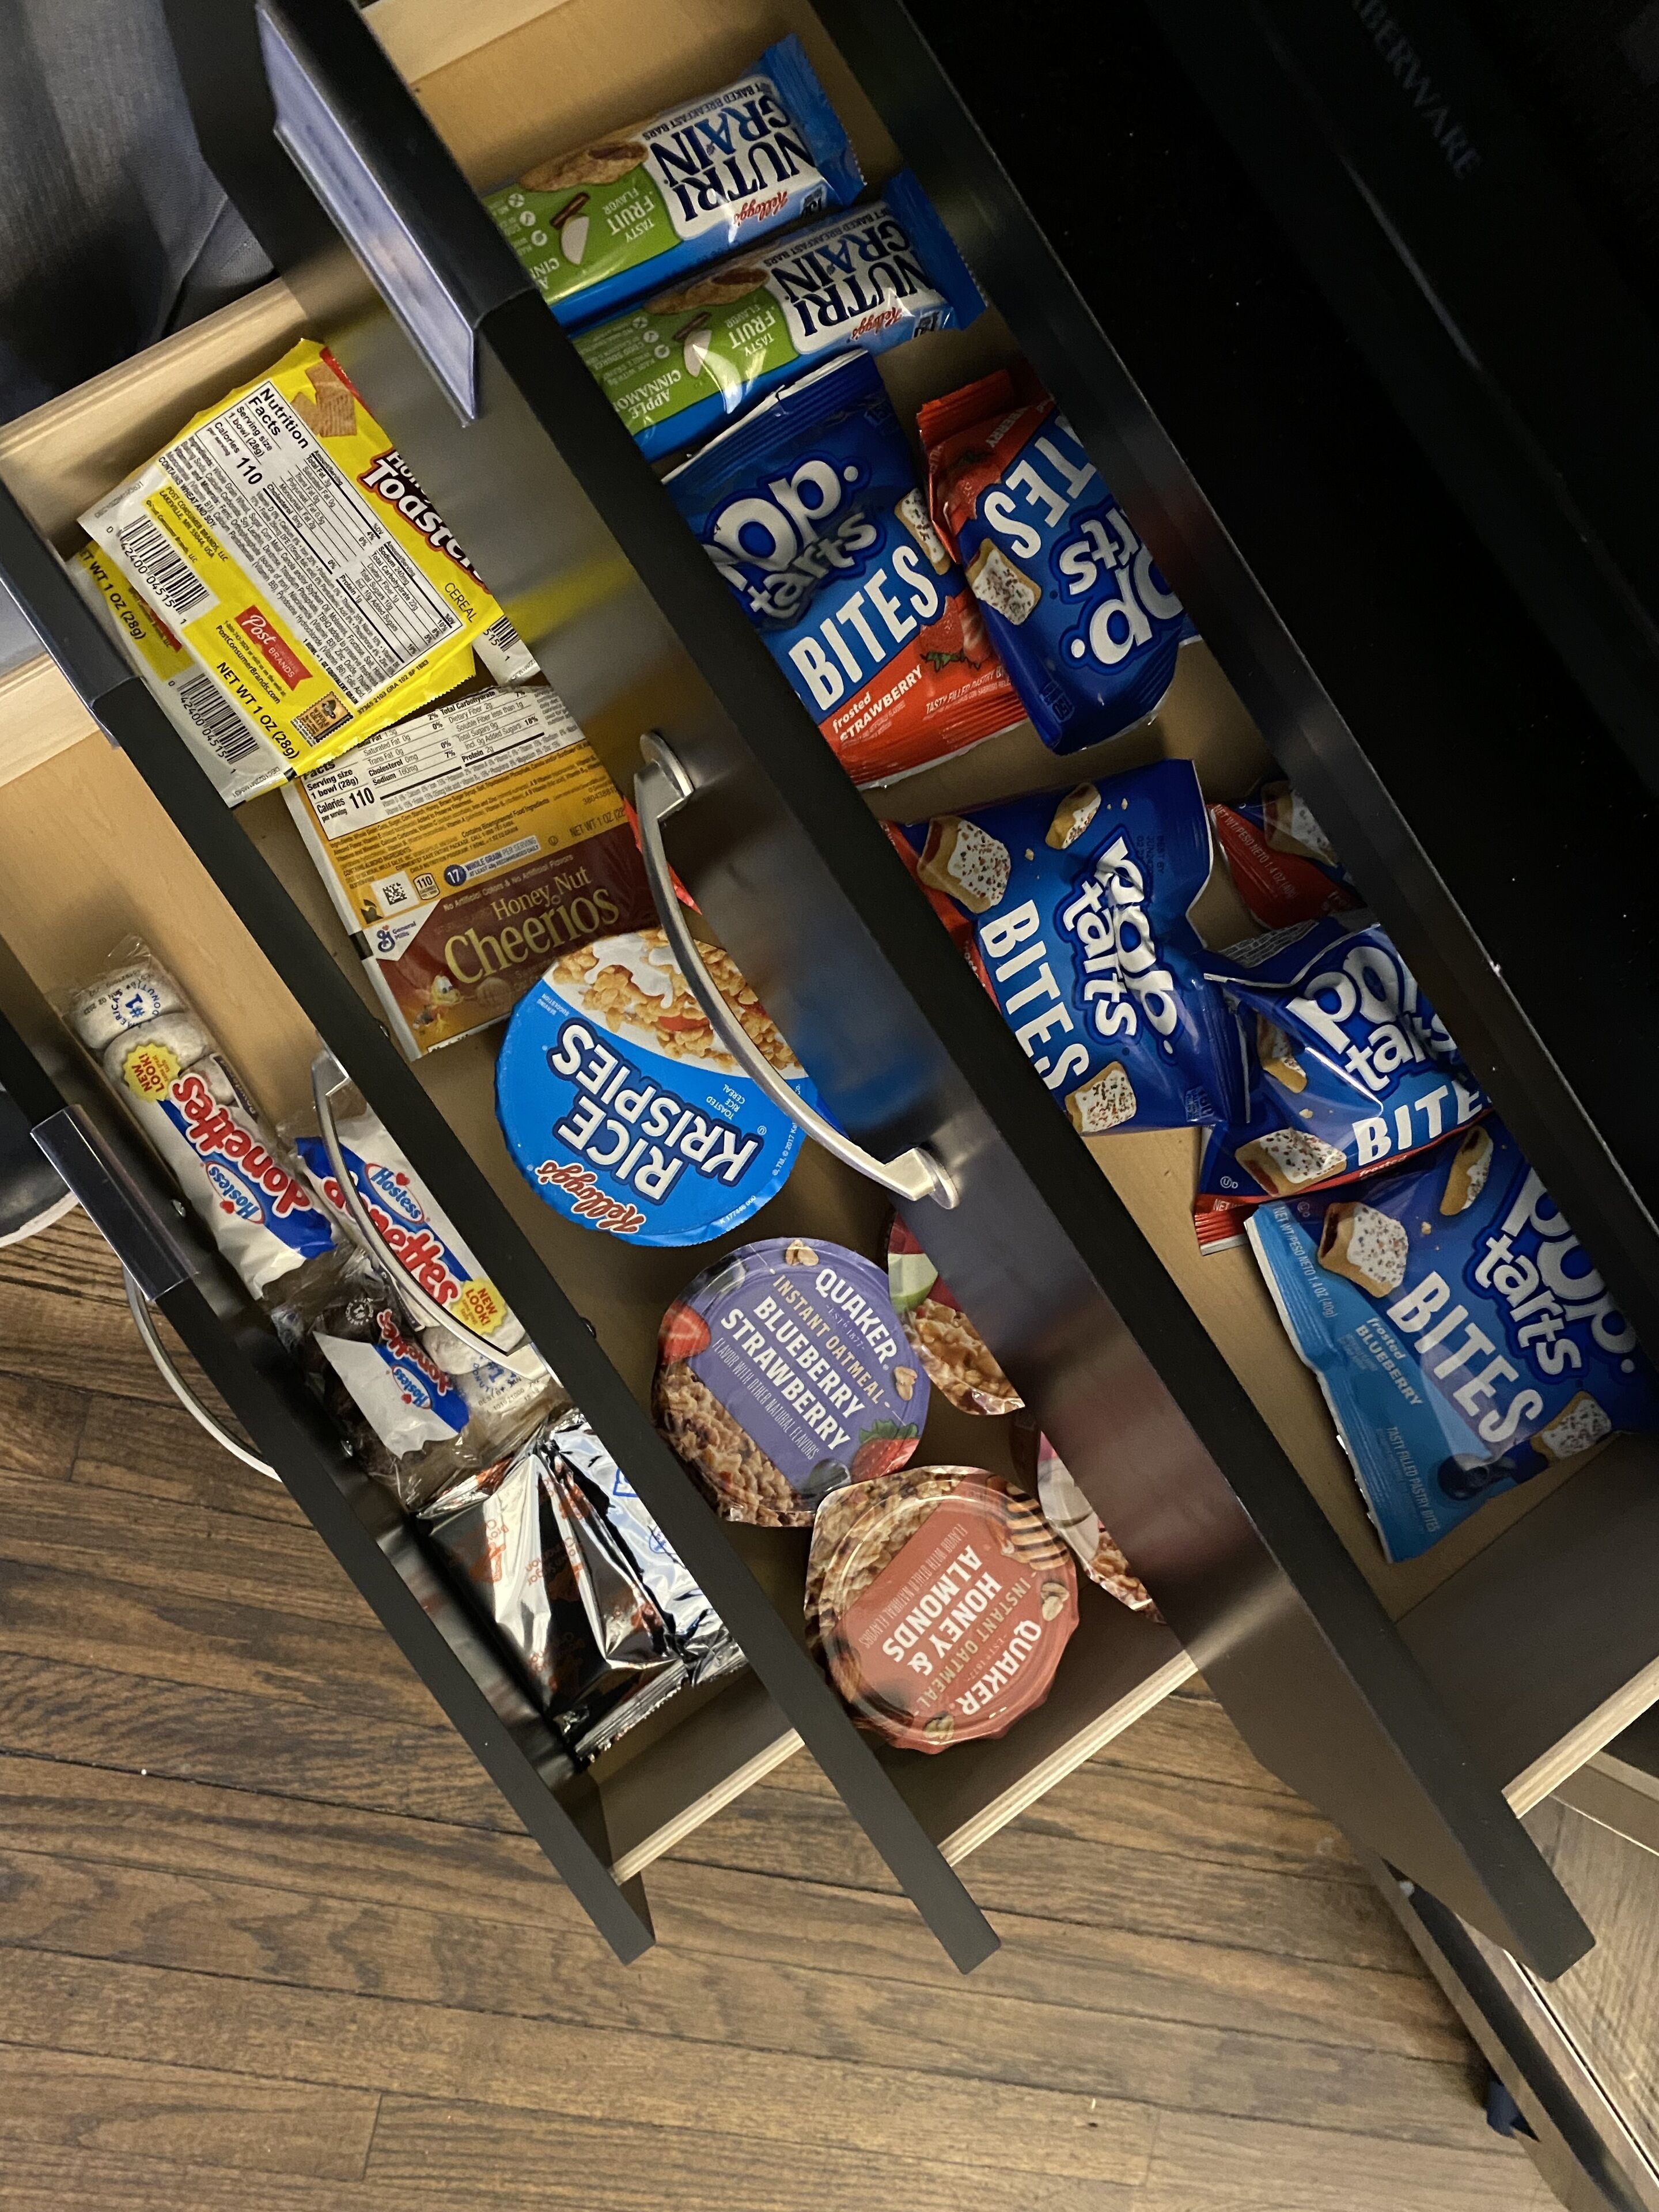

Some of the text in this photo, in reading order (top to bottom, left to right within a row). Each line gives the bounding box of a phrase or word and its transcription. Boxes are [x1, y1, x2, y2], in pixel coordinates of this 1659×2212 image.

[642, 84, 755, 141] BAKED BREAKFAST BARS
[652, 91, 791, 188] GRAIN
[600, 187, 641, 214] FLAVOR
[672, 130, 815, 223] NUTRI
[604, 196, 657, 235] FRUIT
[622, 218, 656, 243] TASTY
[733, 191, 789, 228] Kellogg's
[763, 215, 873, 267] BAKED BREAKFAST BARS
[772, 219, 910, 304] GRAIN
[722, 302, 762, 328] FLAVOR
[792, 257, 927, 338] NUTRI
[850, 305, 903, 339] Kellogg's
[723, 310, 778, 349] FRUIT
[741, 332, 775, 355] TASTY
[234, 405, 274, 452] Serving size
[247, 395, 283, 437] Facts
[259, 387, 312, 449] Nutrition
[627, 388, 674, 419] APPLE
[214, 421, 241, 453] Calories
[232, 418, 266, 459] bowl (28g)
[158, 455, 217, 529] CONTAINS WHEAT AND SOY.
[234, 454, 264, 487] 110
[984, 426, 1097, 559] TES
[165, 485, 228, 562] POST CONSUMER LLC
[181, 517, 193, 530] MN
[203, 546, 215, 559] USA
[1059, 507, 1141, 595] rts
[120, 541, 148, 575] 42400
[146, 574, 175, 609] 04515
[751, 510, 877, 619] tarts
[88, 560, 147, 642] WT 1 OZ (28g)
[443, 581, 479, 623] CEREAL
[789, 544, 939, 711] BITES
[240, 611, 278, 652] Post
[215, 623, 281, 706] PostConsumerBrands.com
[267, 646, 294, 679] BRANDS
[179, 695, 205, 728] 42400
[202, 726, 228, 759] 04515
[215, 660, 240, 687] NET
[235, 684, 256, 707] WT
[251, 704, 263, 714] 1
[259, 713, 277, 733] OZ
[270, 728, 301, 762] (28g)
[833, 692, 872, 734] frosted
[839, 665, 922, 741] STRAWBERRY
[923, 695, 949, 714] TASTY
[306, 768, 353, 791] Serving size
[316, 796, 346, 815] Calories
[317, 776, 359, 797] bowl (28g)
[347, 786, 376, 810] 110
[569, 812, 613, 838] NET WT 1 OZ
[1213, 803, 1228, 820] NET
[1224, 813, 1255, 850] WT/PESO
[1248, 841, 1269, 865] NETO
[1271, 870, 1285, 884] OZ
[416, 875, 433, 889] 110
[442, 902, 453, 911] No
[453, 891, 480, 907] Artificial
[521, 863, 548, 879] Artificial
[548, 853, 574, 868] Flavors
[446, 869, 461, 884] 17
[493, 866, 592, 922] Honey Nut
[445, 888, 620, 984] Cheerios
[1065, 881, 1137, 1037] tarts
[123, 993, 147, 1019] #1
[980, 899, 1089, 1092] BITES
[130, 1062, 154, 1092] NEW
[136, 1052, 168, 1093] LOOK!
[720, 1083, 747, 1104] CEREAL
[552, 1024, 763, 1182] KRISPIES
[703, 1095, 736, 1120] TOASTED
[724, 1097, 741, 1112] RICE
[1352, 1080, 1485, 1166] BITE
[175, 1076, 311, 1211] donettes
[558, 1105, 684, 1200] RICE
[783, 1134, 796, 1150] 2017
[208, 1164, 261, 1221] Hostess
[372, 1169, 422, 1218] Hostess
[535, 1159, 647, 1234] Kellogg's
[1272, 1205, 1339, 1319] NET WT/PESO NETO OZ (40g)
[460, 1287, 495, 1327] LOOK!
[474, 1286, 501, 1316] NEW
[815, 1268, 897, 1366] QUAKER
[1475, 1234, 1582, 1375] tarts
[752, 1296, 865, 1419] BLUEBERRY
[772, 1274, 885, 1403] INSTANT OATMEAL
[1354, 1325, 1423, 1406] BLUEBERRY
[1365, 1316, 1405, 1359] frosted
[1386, 1271, 1544, 1444] BITES
[392, 1364, 429, 1408] Hostess
[710, 1336, 820, 1461] FLAVOR WITH OTHER NATURAL FLAVORS
[720, 1308, 851, 1451] STRAWBERRY
[1385, 1425, 1441, 1533] TASTY FILLED PASTRY BITES
[857, 1522, 968, 1650] FLAVOR WITH OTHER NATURAL FLAVORS
[881, 1544, 984, 1664] ALMONDS
[906, 1571, 1003, 1676] HONEY &
[915, 1575, 1032, 1713] INSTANT OATMEAL
[956, 1622, 1041, 1717] QUAKER
